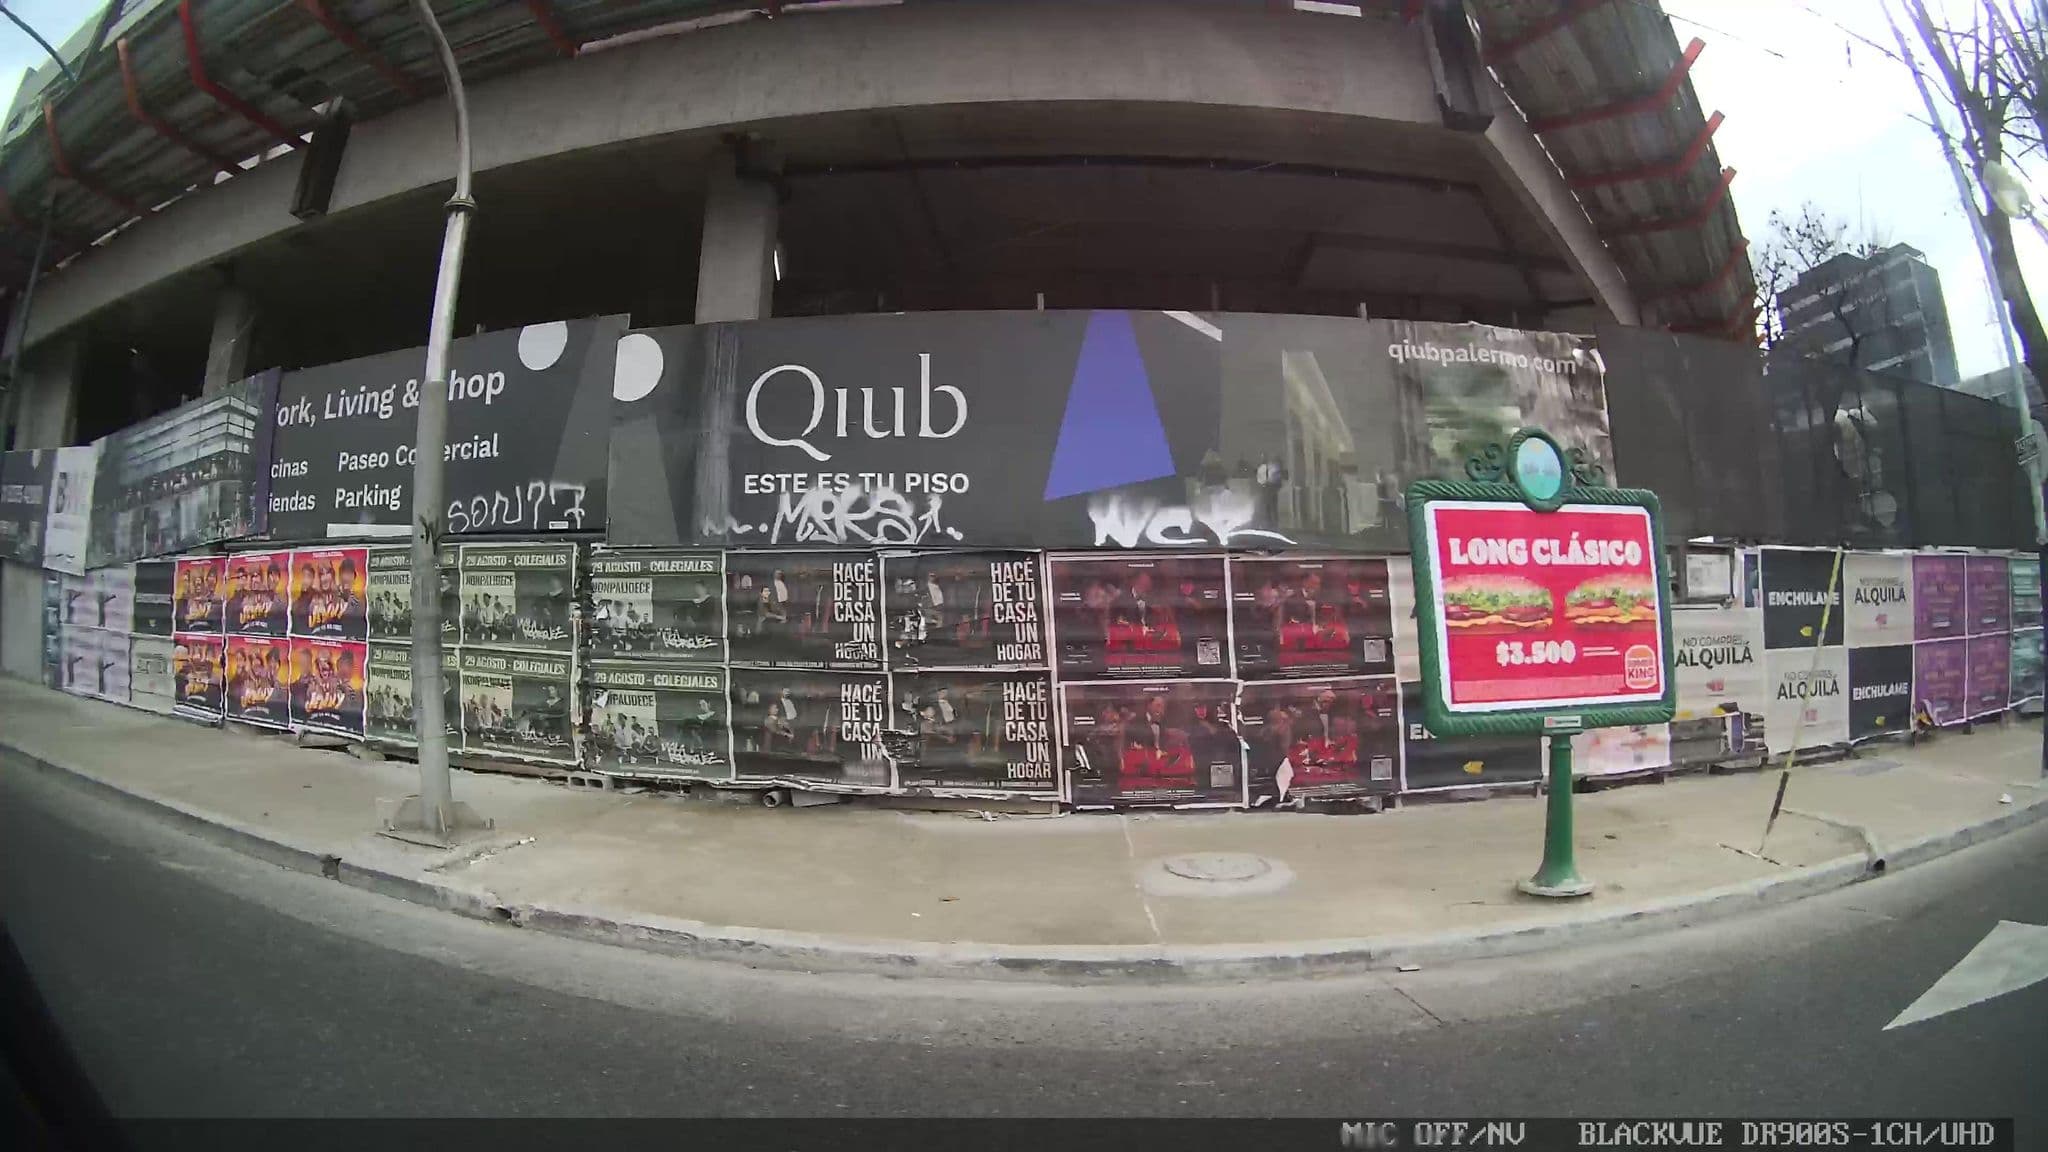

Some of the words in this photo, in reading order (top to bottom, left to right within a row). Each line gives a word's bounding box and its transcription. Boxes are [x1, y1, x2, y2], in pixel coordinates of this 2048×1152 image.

[1388, 340, 1577, 374] qiubpalermocom
[276, 396, 316, 427] ork,
[324, 383, 396, 420] Living
[402, 378, 420, 408] &
[448, 369, 505, 405] hop
[745, 353, 967, 461] Qiub
[338, 449, 389, 472] Paseo
[395, 433, 500, 466] Coercial
[744, 473, 807, 494] ESTE
[817, 473, 850, 493] ES
[857, 473, 894, 493] TU
[906, 473, 969, 494] PISO
[335, 484, 401, 511] Parking
[1449, 537, 1528, 566] LONG
[1532, 532, 1642, 566] CLÁSICO
[514, 554, 566, 566] COLEGIALES
[605, 561, 641, 573] AGOSTO
[650, 561, 713, 572] COLEGIALES
[833, 558, 874, 582] HACÉ
[991, 557, 1034, 582] HACÉ
[833, 583, 852, 601] DE
[855, 583, 875, 601] TU
[992, 583, 1012, 602] DE
[1015, 582, 1035, 601] TU
[834, 602, 875, 622] CASA
[993, 602, 1037, 622] CASA
[854, 623, 875, 642] UN
[1015, 623, 1038, 643] UN
[997, 644, 1041, 661] HOGAR
[1496, 640, 1576, 667] $3.500
[1675, 641, 1753, 669] ALQUILÁ
[465, 656, 475, 666] 29
[476, 657, 506, 670] AGOSTO
[513, 660, 565, 674] COLEGIALES
[594, 673, 606, 684] 29
[608, 673, 645, 685] AGOSTO
[654, 675, 718, 688] COLEGIALES
[1003, 677, 1046, 701] HACÉ
[841, 680, 882, 703] HACÉ
[841, 703, 860, 720] DE
[863, 703, 882, 721] TU
[1004, 702, 1024, 720] DE
[1027, 702, 1047, 720] TU
[842, 722, 880, 742] CASA
[1005, 721, 1049, 742] CASA
[1026, 742, 1049, 762] UN
[1007, 763, 1051, 779] HOGAR
